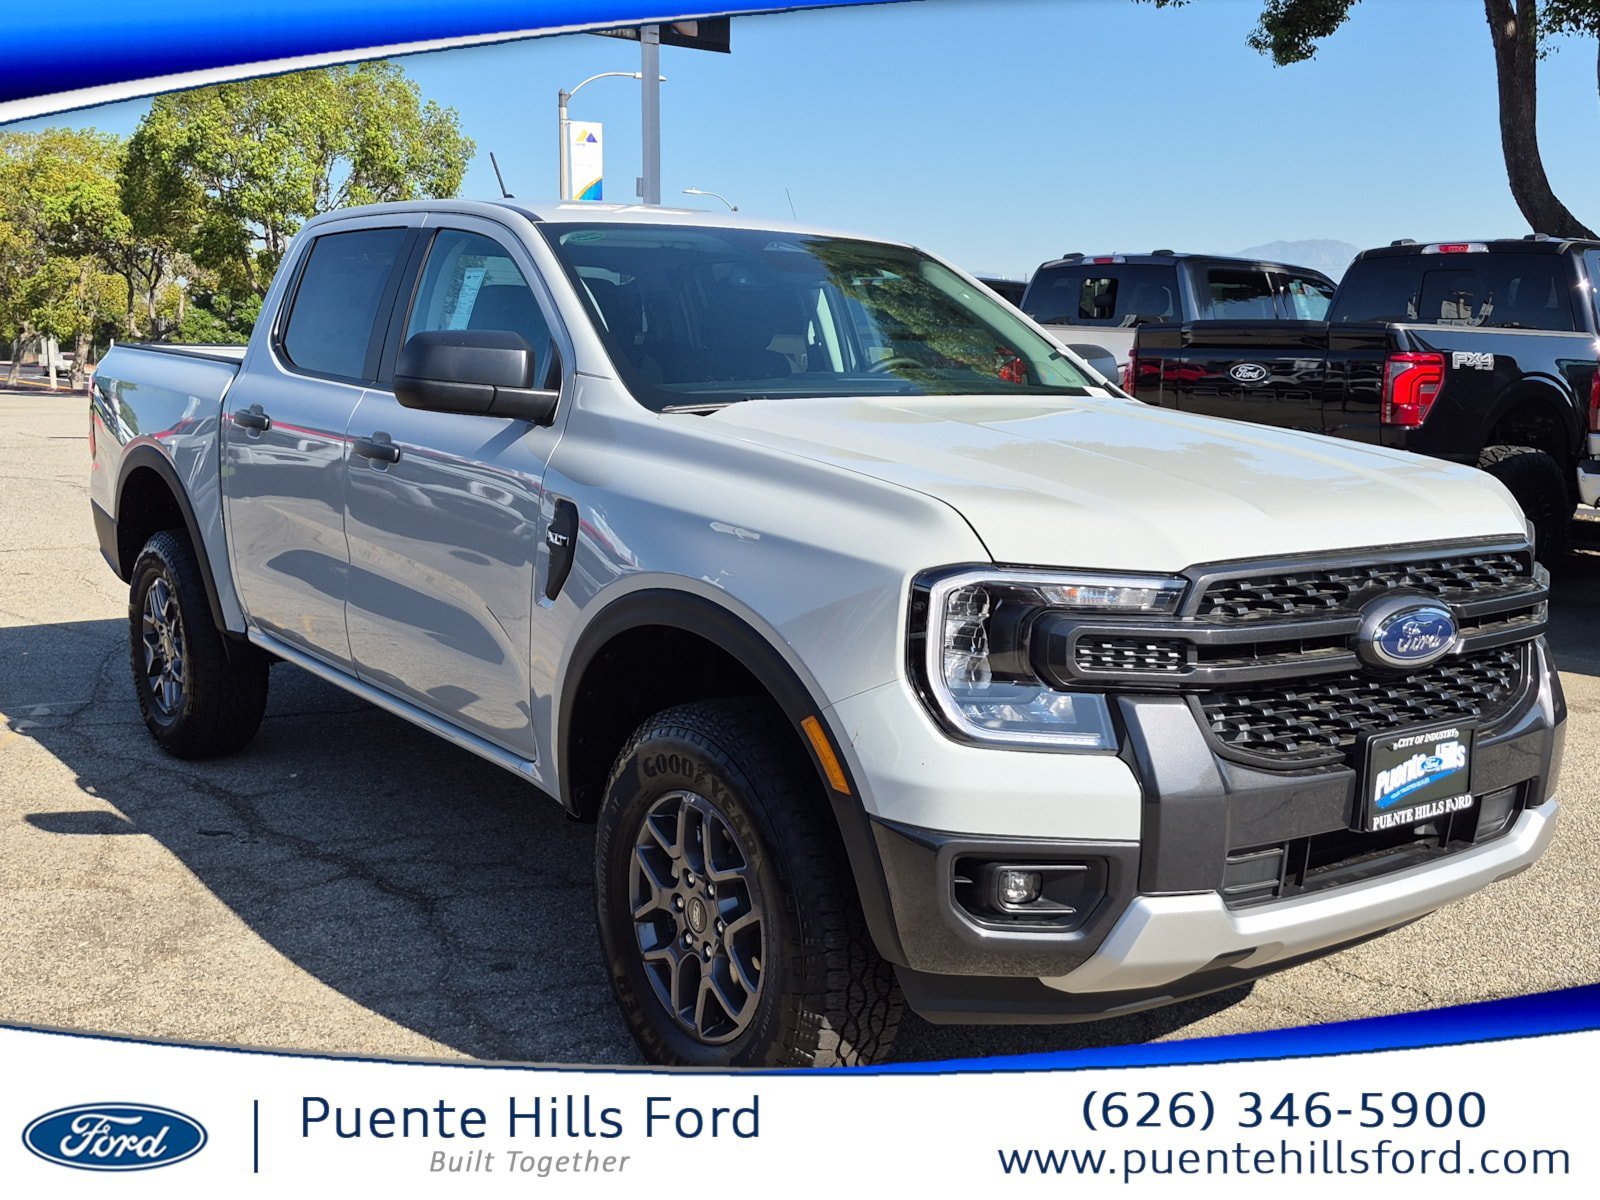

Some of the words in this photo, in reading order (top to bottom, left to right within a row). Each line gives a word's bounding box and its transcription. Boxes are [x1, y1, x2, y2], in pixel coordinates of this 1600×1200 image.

[1452, 351, 1494, 370] FX4
[1235, 366, 1260, 379] Ford
[547, 529, 567, 547] XLT
[1397, 621, 1442, 653] Ford
[1398, 736, 1414, 748] CITY
[1414, 734, 1424, 744] OF
[1424, 728, 1457, 743] INDUSTRY
[1375, 753, 1427, 802] Puente
[1435, 740, 1466, 771] Hills
[1373, 808, 1413, 831] PUENTE
[1414, 801, 1445, 820] HILLS
[1446, 794, 1473, 812] FORD
